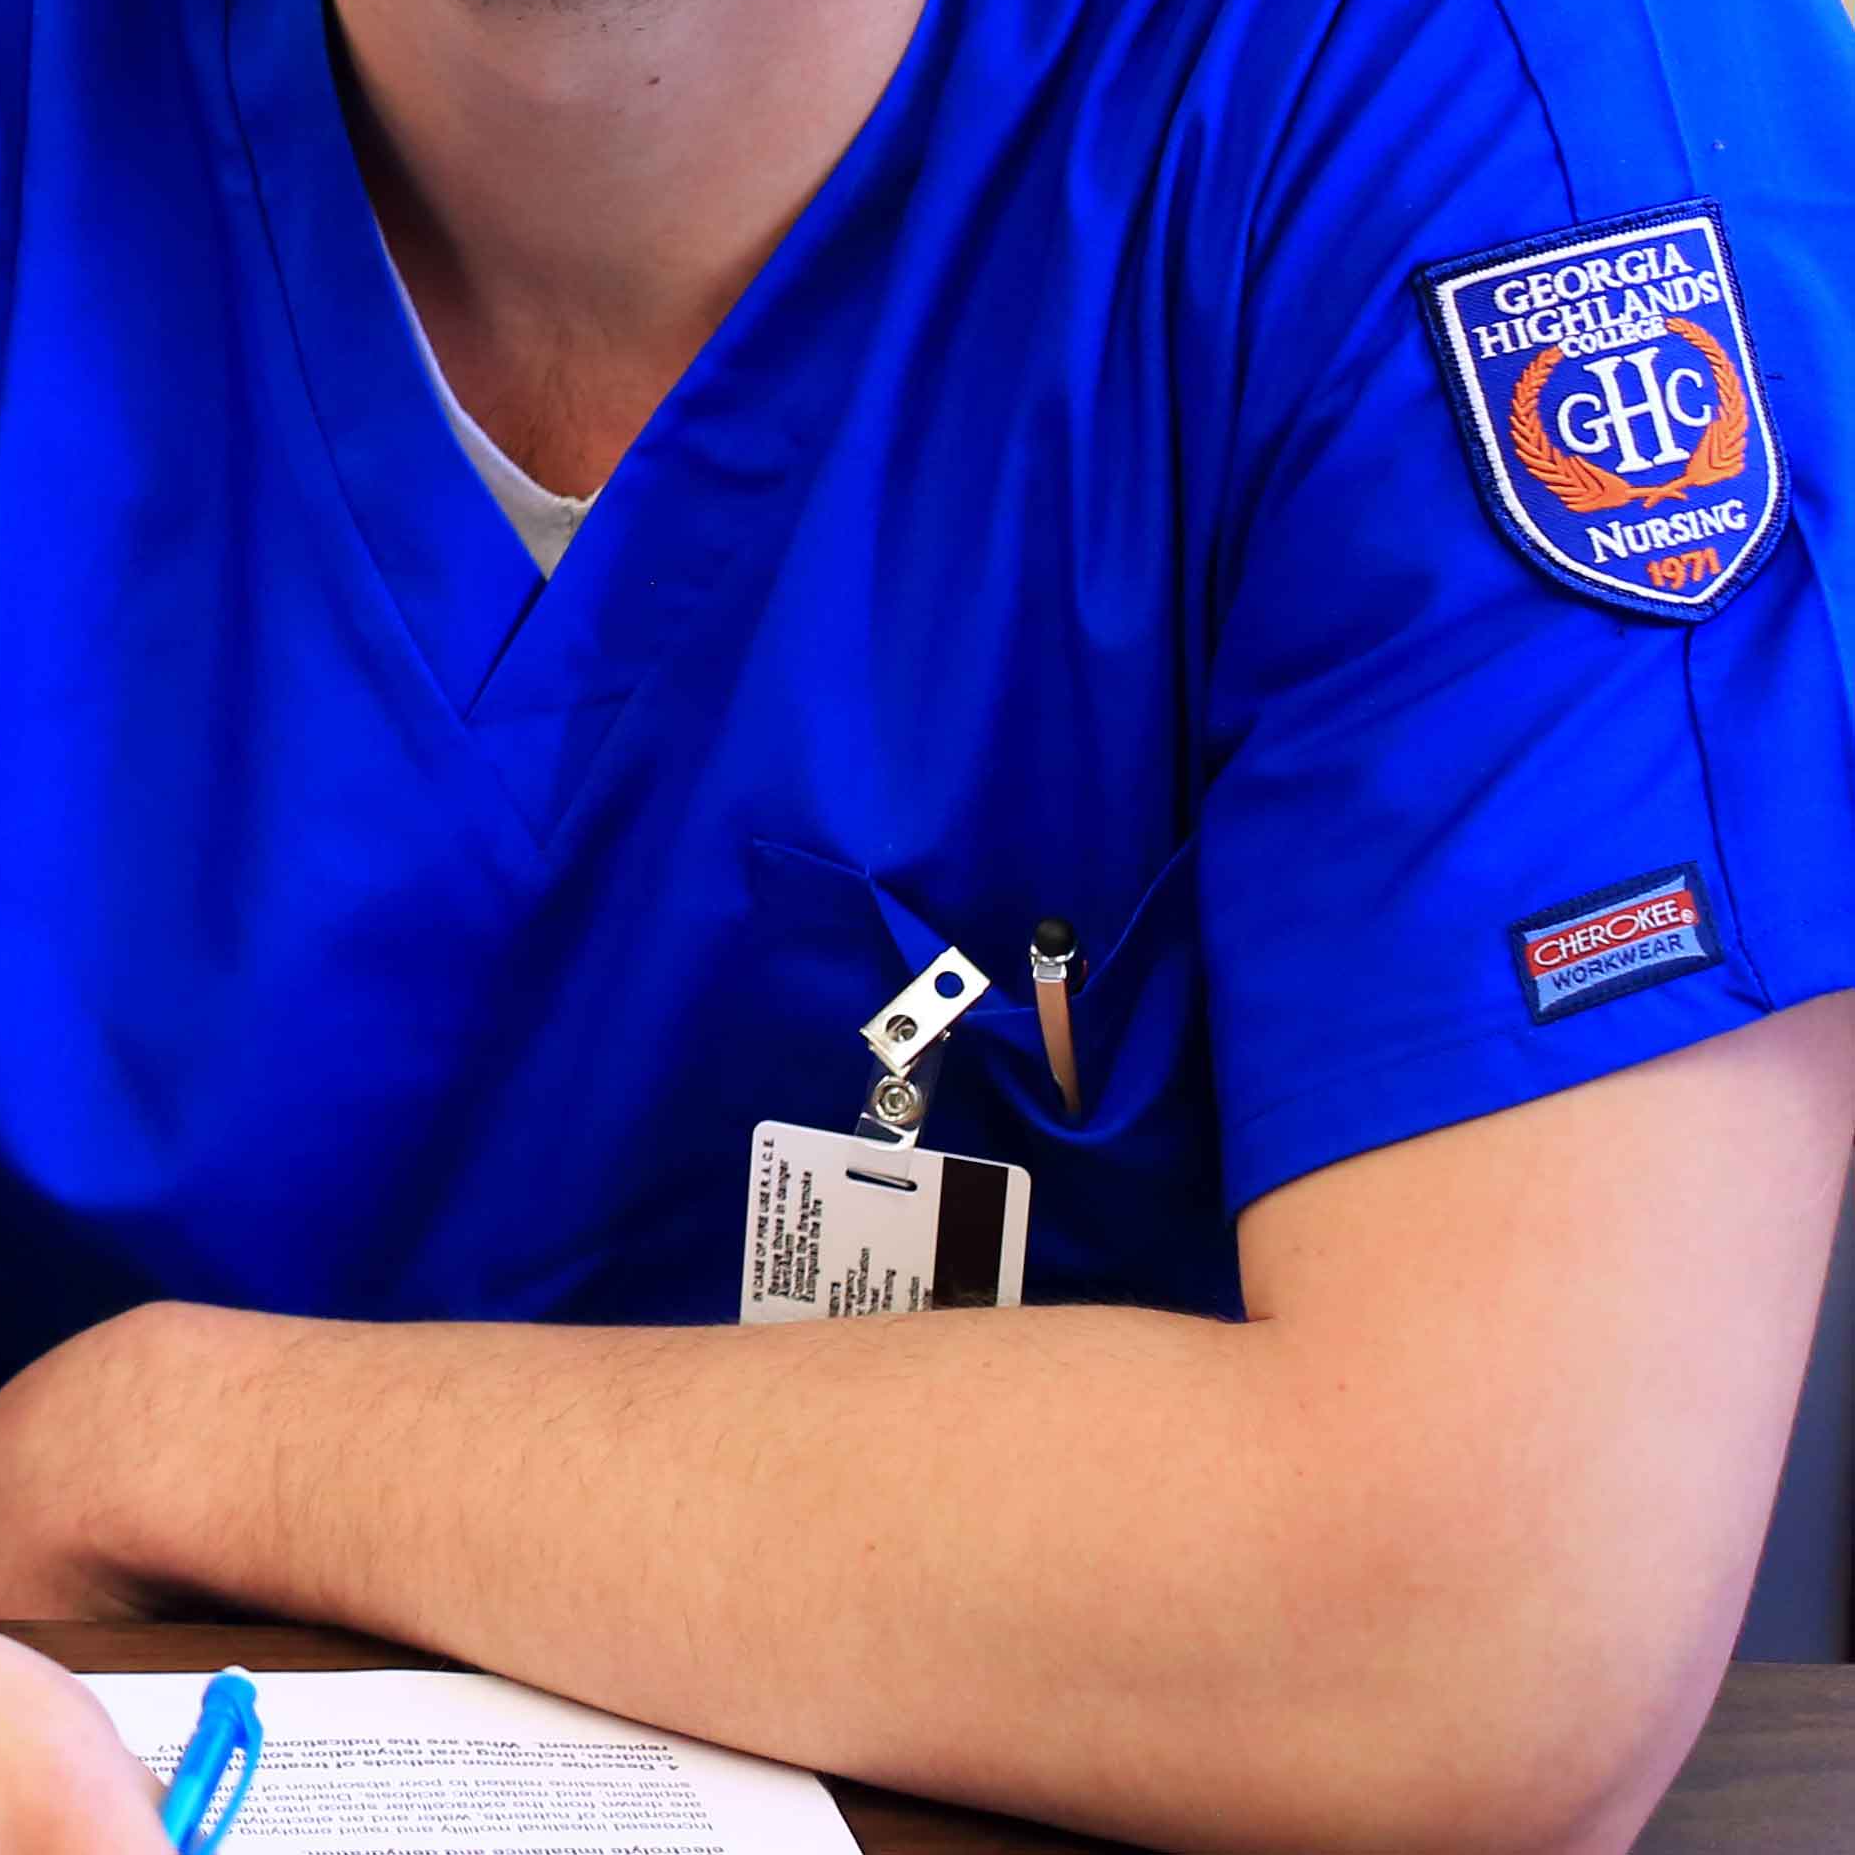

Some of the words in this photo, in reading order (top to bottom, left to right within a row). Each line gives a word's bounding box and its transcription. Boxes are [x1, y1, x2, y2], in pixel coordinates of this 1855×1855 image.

[1494, 243, 1695, 315] GEORGIA
[1473, 270, 1721, 359] HIGHLANDS
[1559, 316, 1671, 359] COLLEGE
[1556, 347, 1712, 474] GHC
[1586, 499, 1747, 565] NURSING
[1646, 548, 1722, 590] 1971
[1533, 899, 1680, 967] CHEROKEE
[1552, 934, 1685, 991] WORKWEAR
[774, 1159, 790, 1201] danger
[759, 1191, 771, 1213] USE
[797, 1171, 812, 1232] fire/smoke
[773, 1204, 786, 1214] in
[809, 1199, 823, 1218] fire
[757, 1215, 768, 1239] FIRE
[808, 1222, 821, 1239] the
[770, 1218, 785, 1250] those
[795, 1235, 807, 1253] the
[755, 1242, 766, 1257] OF
[753, 1260, 765, 1288] CASE
[768, 1254, 784, 1295] Rescue
[792, 1257, 806, 1299] Contain
[805, 1243, 820, 1303] Extinguish
[856, 1248, 870, 1304] Notification
[752, 1291, 763, 1302] IN
[466, 1740, 520, 1749] What
[536, 1743, 668, 1751] replacement.
[301, 1748, 423, 1757] rehydration
[430, 1749, 470, 1757] oral
[477, 1749, 575, 1759] including
[581, 1753, 673, 1761] children,
[561, 1762, 656, 1770] Describe
[261, 1784, 279, 1792] of
[286, 1782, 391, 1791] absorption
[399, 1778, 442, 1788] poor
[265, 1793, 352, 1803] Diarrhea
[452, 1790, 548, 1798] metabolic
[599, 1790, 696, 1798] depletion,
[274, 1806, 311, 1814] into
[318, 1803, 378, 1811] space
[384, 1801, 506, 1810] extracellular
[512, 1801, 544, 1809] the
[372, 1815, 408, 1823] and
[417, 1814, 471, 1822] water
[577, 1812, 595, 1820] of
[601, 1810, 707, 1820] absorption
[240, 1827, 332, 1836] emptying
[339, 1826, 389, 1835] rapid
[396, 1826, 433, 1834] and
[441, 1825, 511, 1834] motility
[517, 1824, 607, 1832] intestinal
[613, 1823, 713, 1831] Increased
